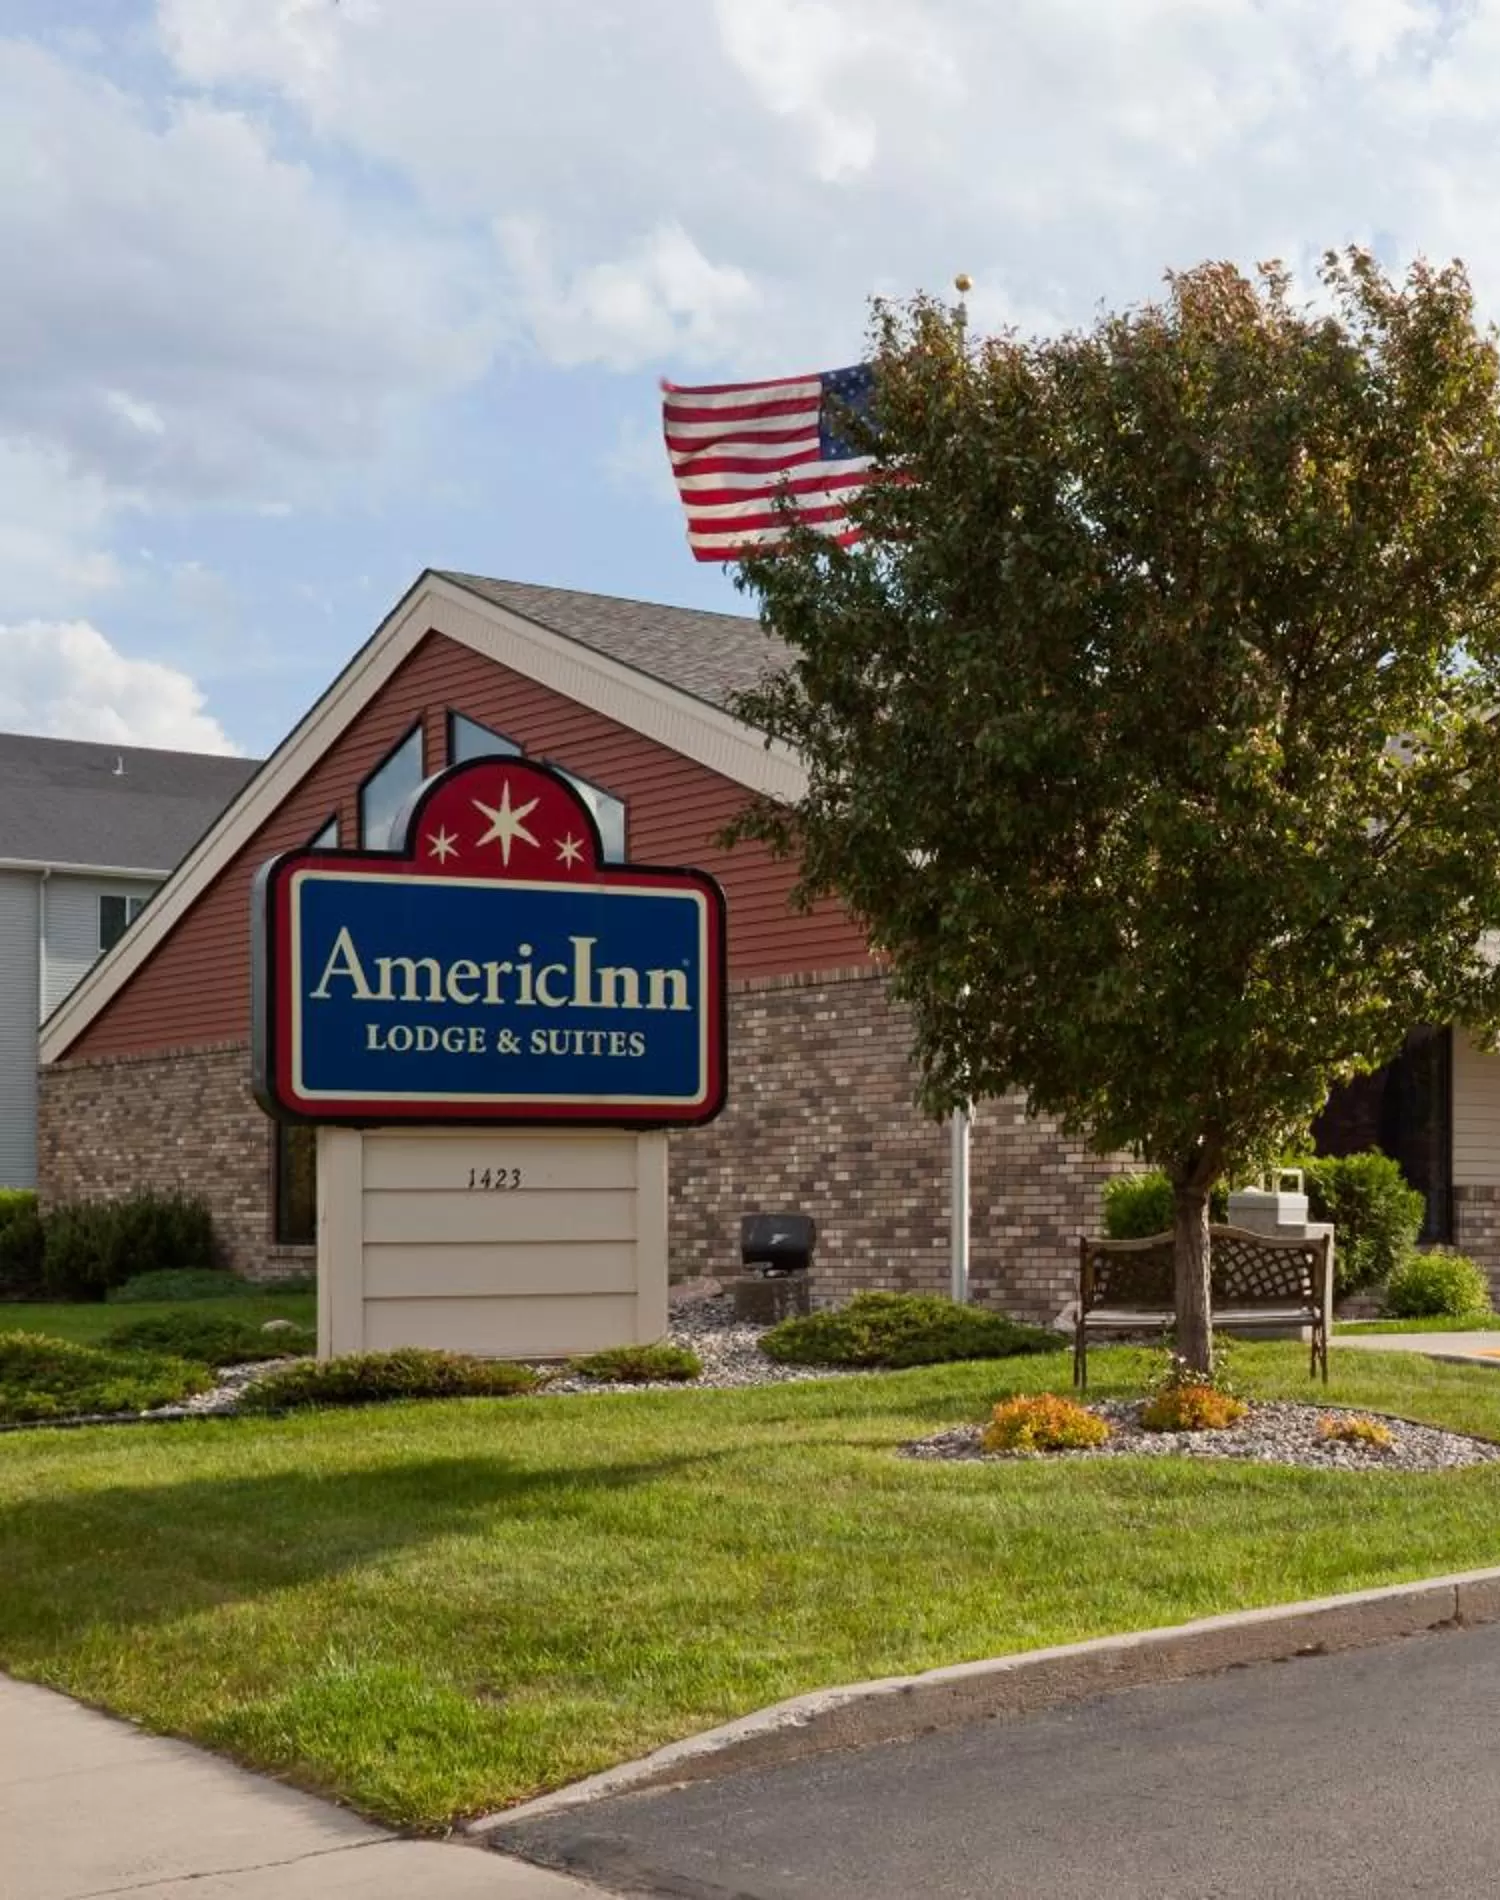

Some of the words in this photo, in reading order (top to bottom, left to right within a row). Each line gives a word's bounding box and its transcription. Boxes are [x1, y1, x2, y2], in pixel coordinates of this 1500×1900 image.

[309, 926, 692, 1011] AmericInn
[366, 1023, 487, 1053] LODGE
[496, 1028, 521, 1055] &
[529, 1029, 646, 1057] SUITES
[468, 1167, 521, 1190] 1423
